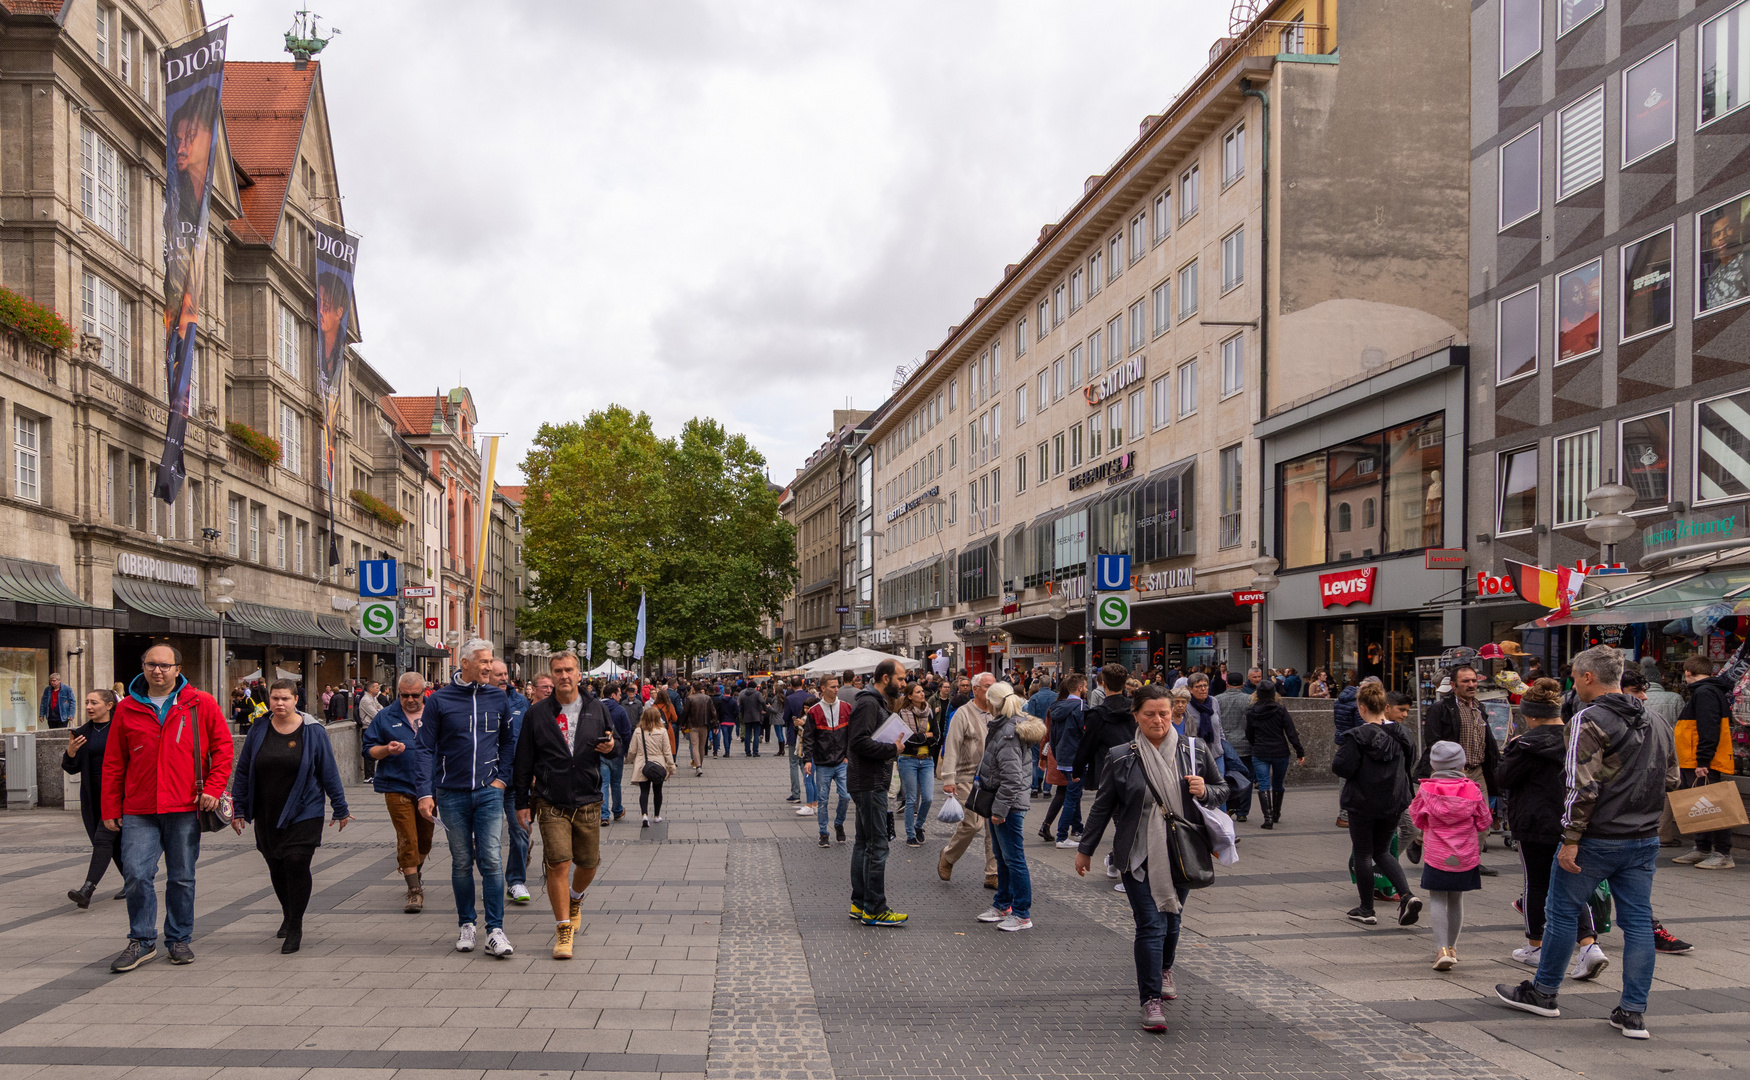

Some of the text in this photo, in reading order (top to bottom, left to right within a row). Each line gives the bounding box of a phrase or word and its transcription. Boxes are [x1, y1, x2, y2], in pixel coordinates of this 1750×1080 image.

[165, 39, 225, 84] DIOR
[316, 230, 355, 265] DIOR
[1100, 354, 1142, 401] SATURN
[1081, 460, 1113, 486] BEAUTY
[1112, 450, 1136, 474] SPOT
[1676, 515, 1735, 539] Zeitung
[118, 552, 198, 586] OBERPOLLINGER
[365, 562, 389, 594] U
[1103, 557, 1124, 588] U
[1149, 567, 1194, 592] SATURN
[1061, 575, 1087, 600] SATU
[1477, 571, 1514, 596] Foo
[368, 606, 389, 632] S
[1104, 599, 1123, 624] S
[1688, 806, 1722, 818] adidas
